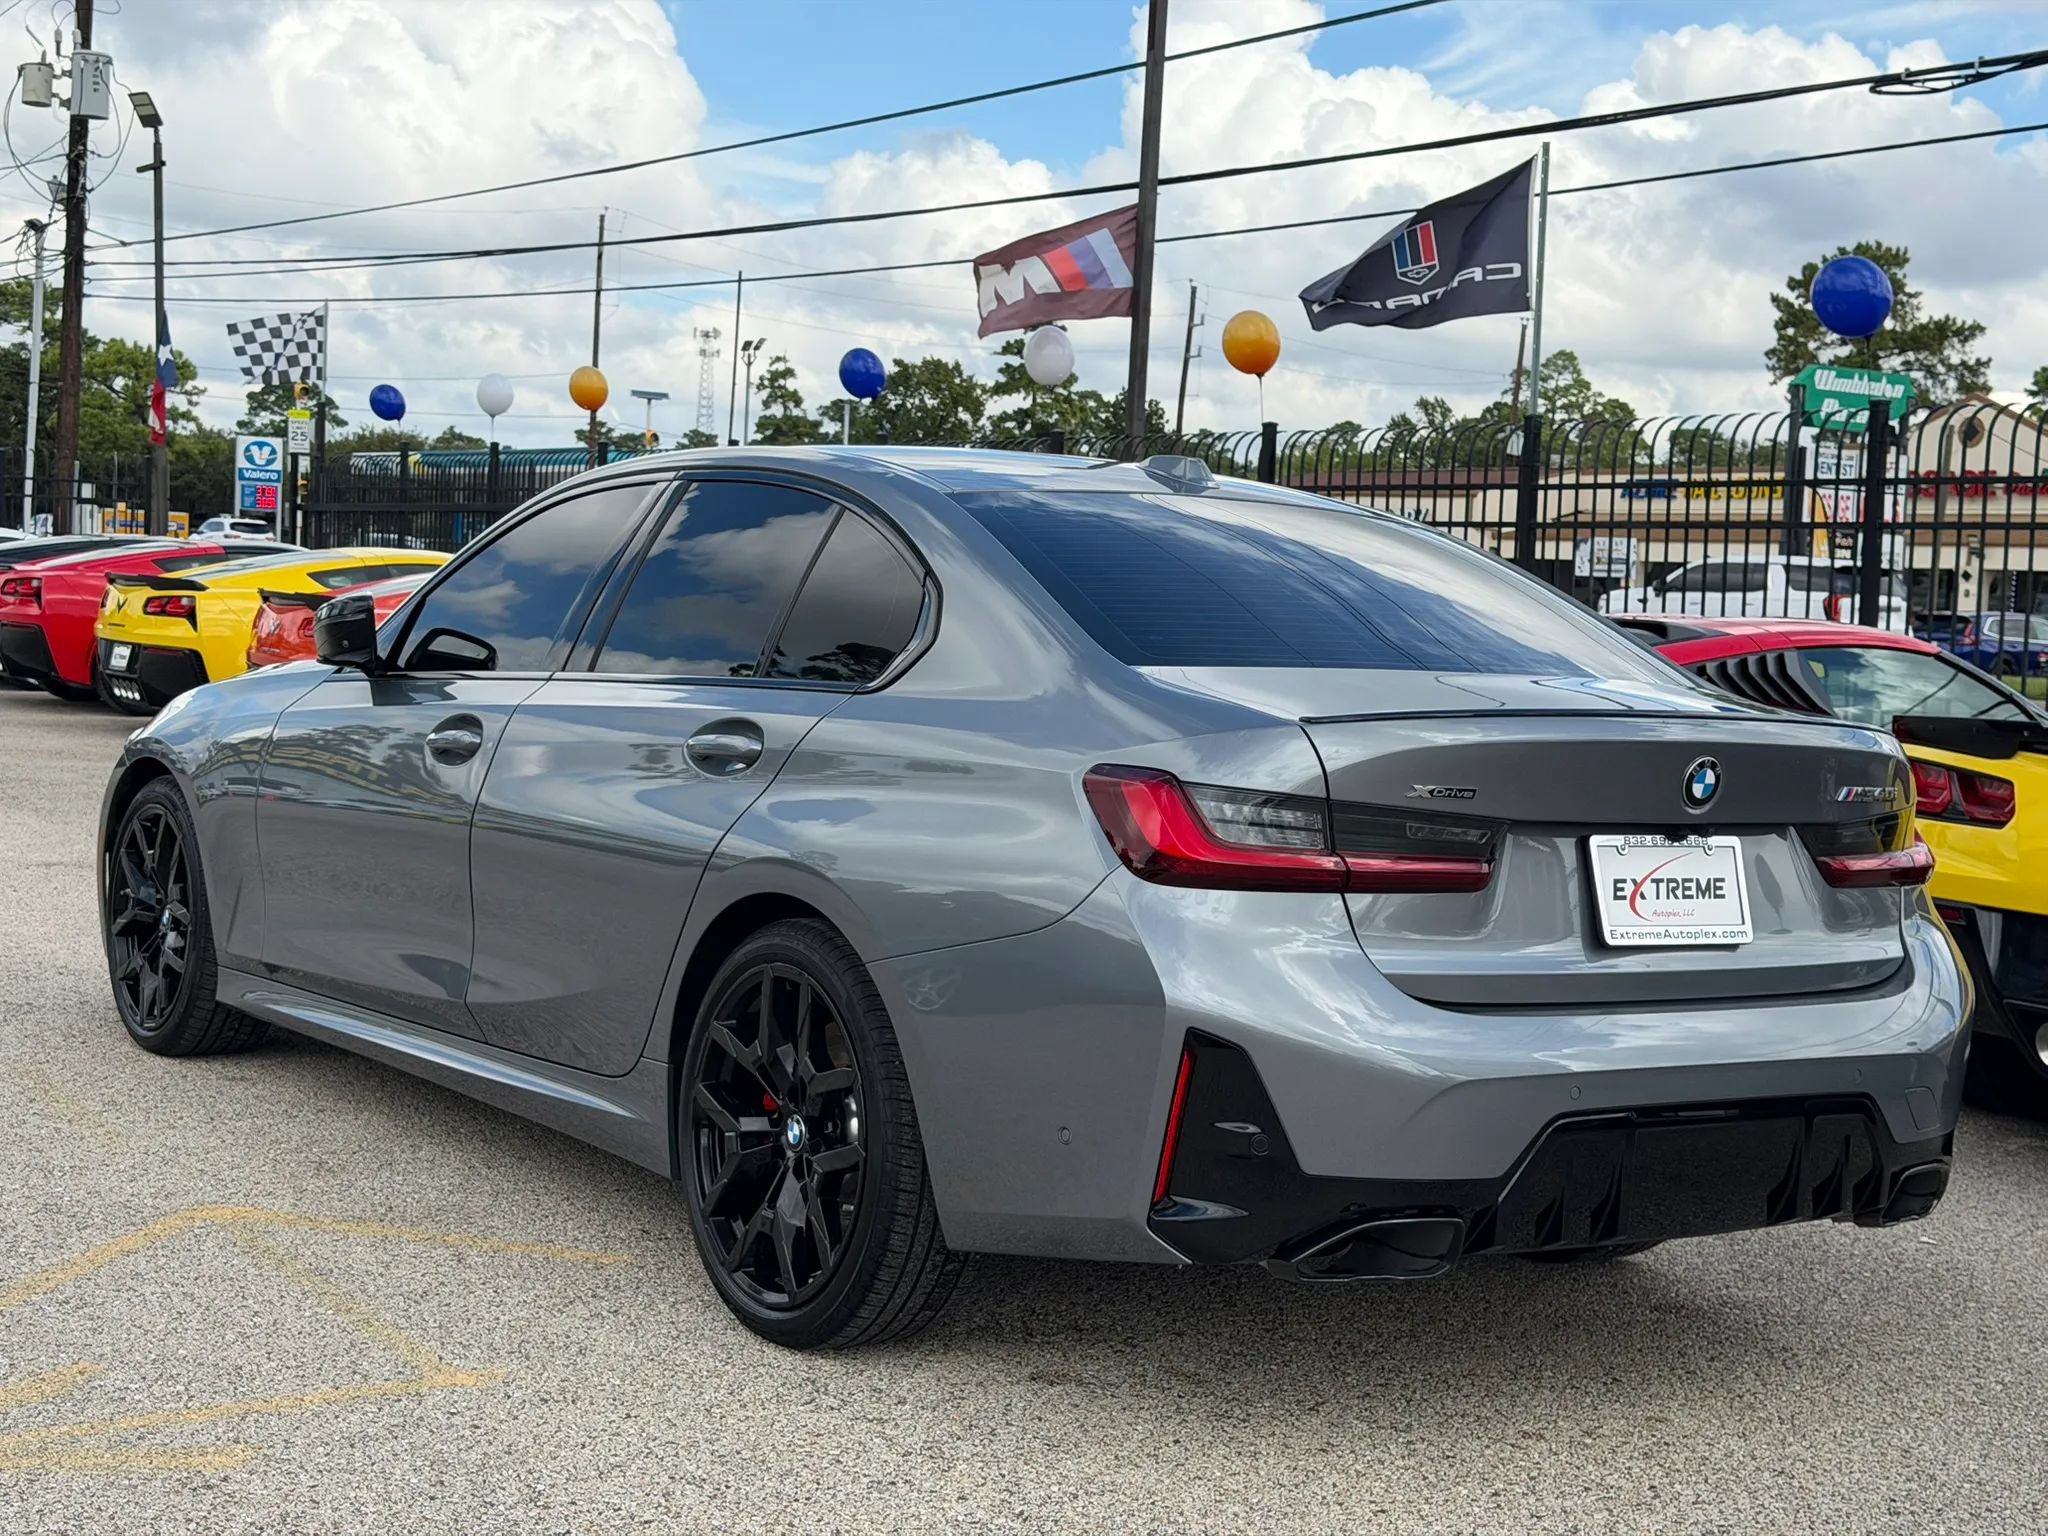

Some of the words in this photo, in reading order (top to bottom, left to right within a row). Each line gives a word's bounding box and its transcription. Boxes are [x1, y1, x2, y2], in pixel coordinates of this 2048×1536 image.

[291, 431, 308, 441] 25
[243, 469, 278, 479] Valero
[1612, 877, 1726, 901] EXTREME
[1682, 908, 1696, 917] LLC
[1610, 929, 1748, 941] ExtremeAutoplex.com
